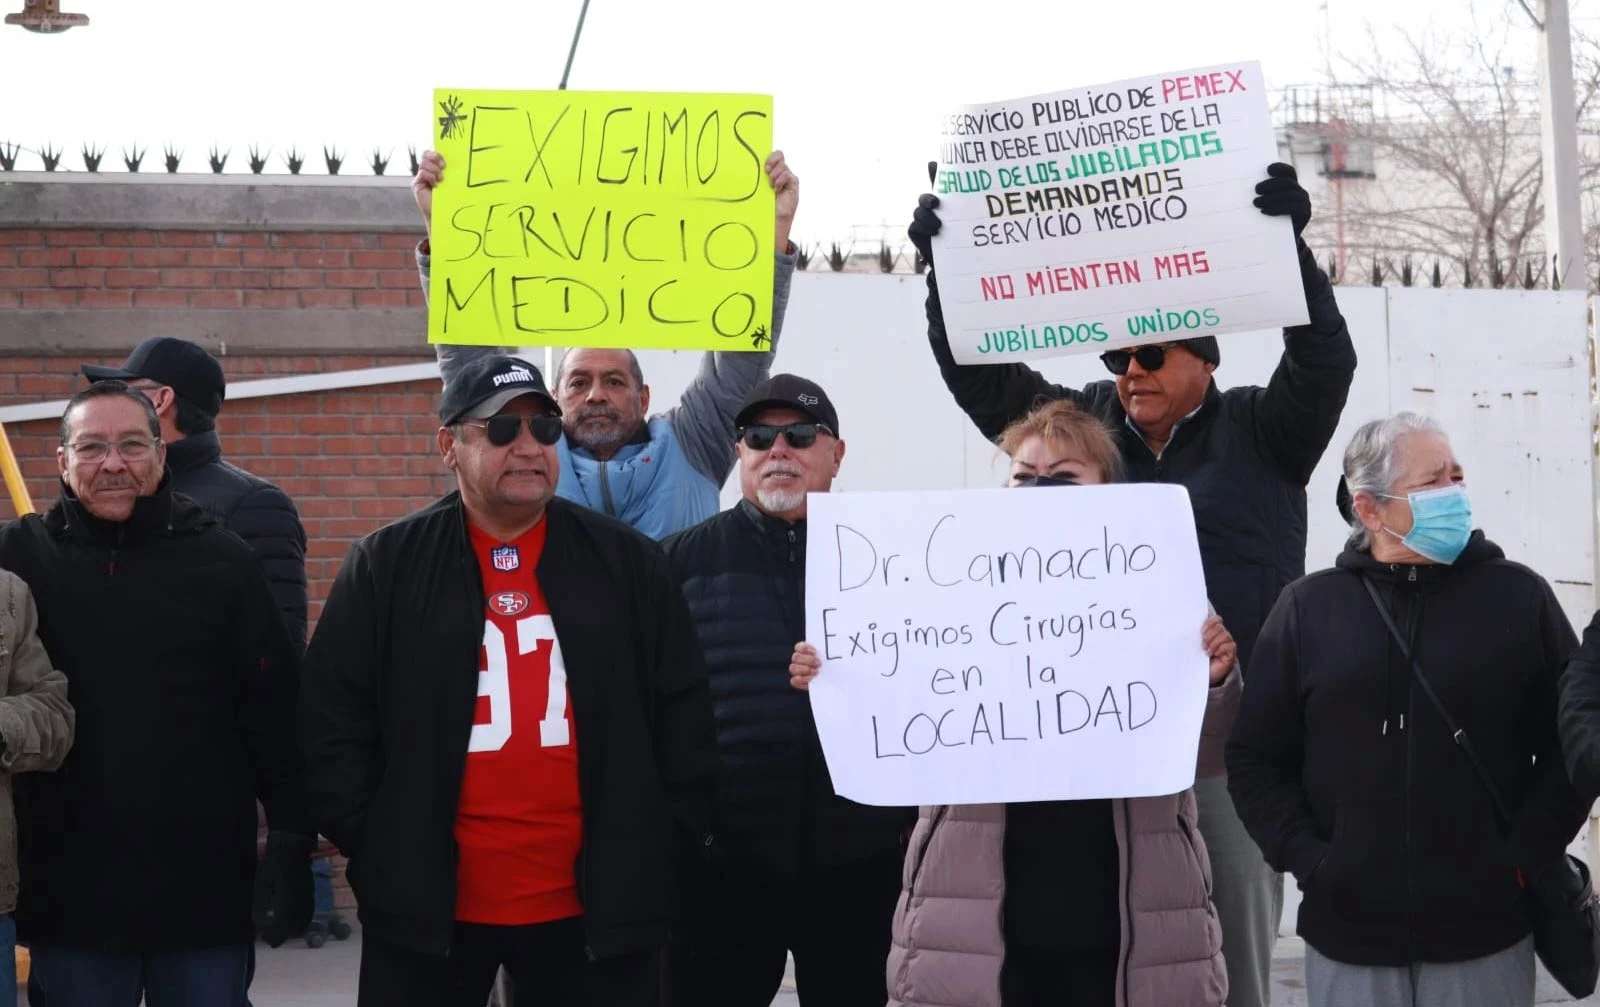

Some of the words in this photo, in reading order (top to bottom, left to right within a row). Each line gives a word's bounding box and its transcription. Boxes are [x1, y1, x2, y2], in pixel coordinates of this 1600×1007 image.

[1032, 90, 1122, 127] PUBLICO
[1128, 86, 1156, 110] DE
[1161, 70, 1247, 104] PEMEX
[466, 104, 767, 203] EXIGIMOS
[990, 136, 1041, 161] DEBE
[1044, 115, 1156, 153] OLVIDARSE
[1161, 109, 1188, 132] DE
[1193, 103, 1222, 126] LA
[938, 168, 992, 195] SALUD
[1065, 131, 1224, 180] JUBILADOS
[972, 208, 1082, 247] SERVICIO
[1093, 195, 1188, 232] MEDICO
[985, 168, 1184, 219] DEMANDAMOS
[444, 204, 759, 271] SERVICIO
[980, 274, 1015, 302] NO
[1026, 259, 1142, 297] MIENTAN
[976, 320, 1109, 354] JUBILADOS
[1127, 308, 1221, 337] UNIDOS
[495, 556, 518, 570] NFL
[835, 523, 910, 592] Dr.
[925, 514, 1157, 588] Camacho
[498, 593, 523, 613] SF
[822, 608, 974, 678] Exigimos
[989, 602, 1138, 658] Cirugías
[931, 665, 983, 696] en
[1026, 655, 1057, 689] la
[872, 681, 1158, 759] LOCALIDAD
